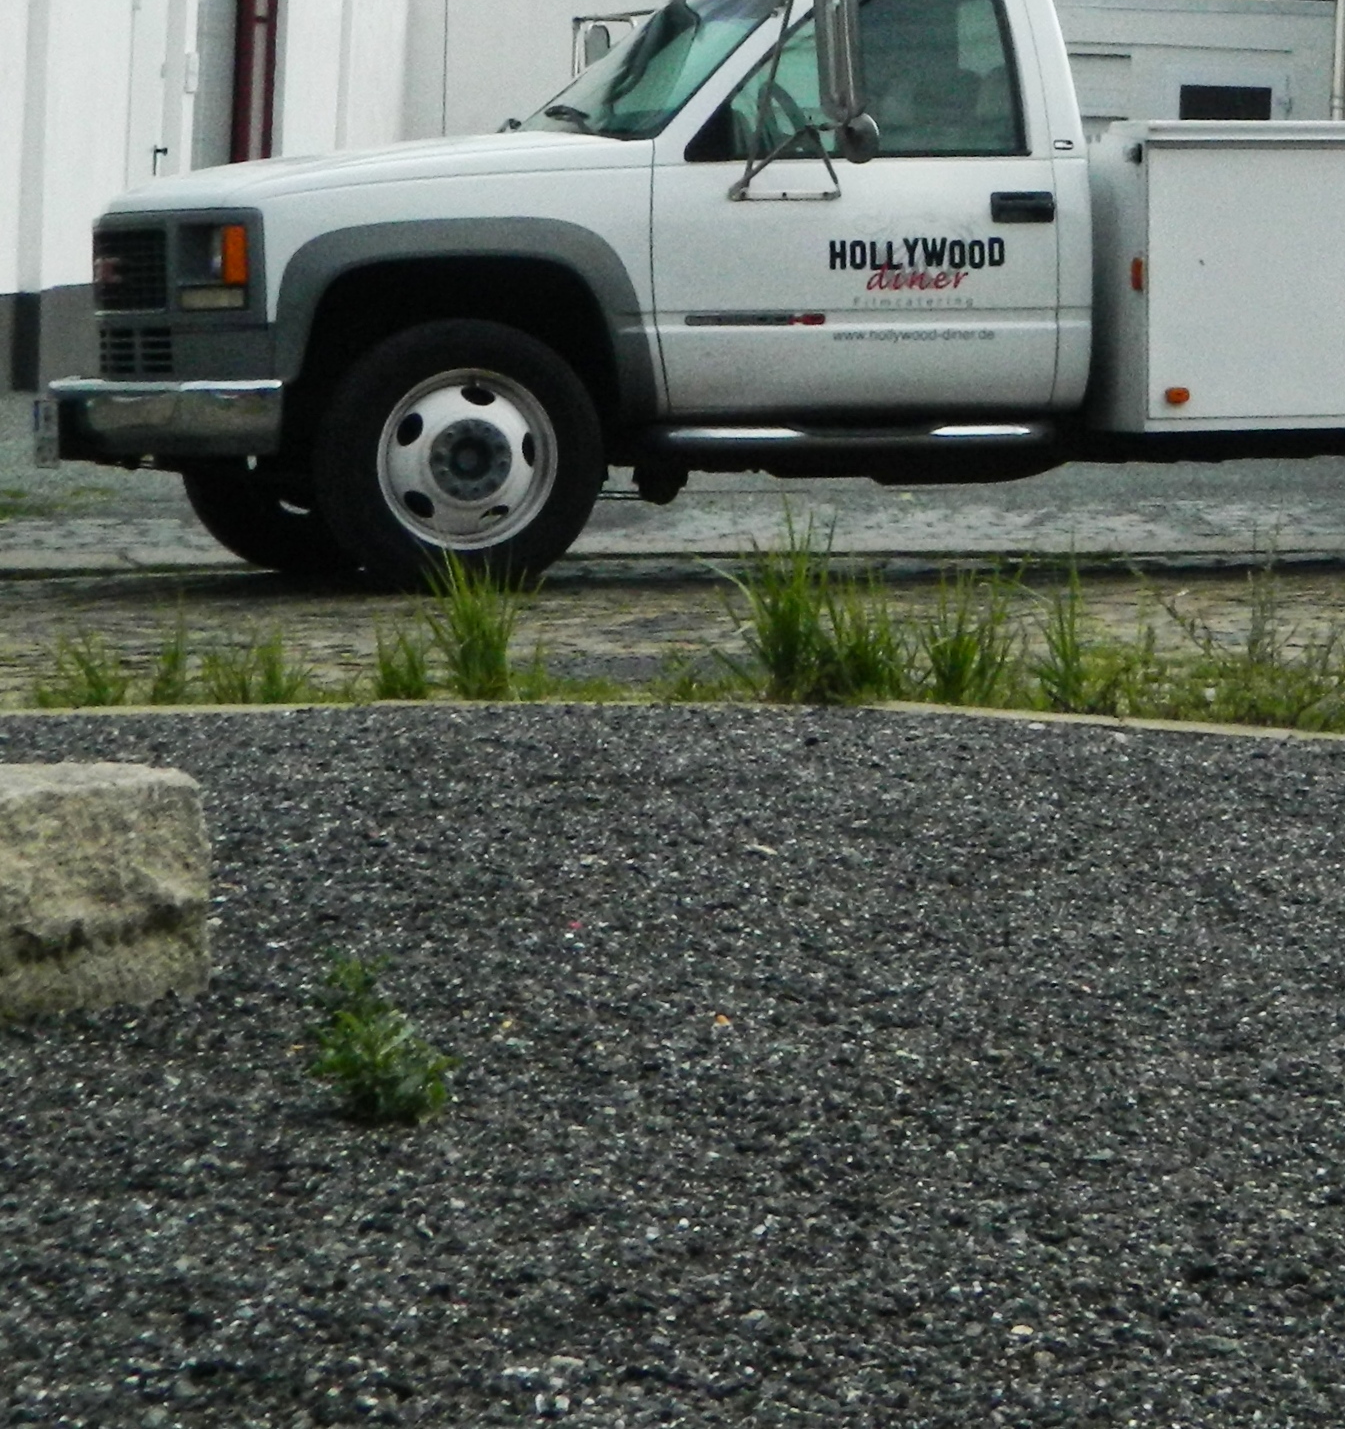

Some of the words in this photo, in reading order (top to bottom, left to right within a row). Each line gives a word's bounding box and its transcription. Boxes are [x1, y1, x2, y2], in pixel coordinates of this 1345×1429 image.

[829, 237, 1005, 270] HOLLYWOOD
[866, 261, 968, 290] diner
[832, 328, 995, 343] www.hollywood-diner.de
